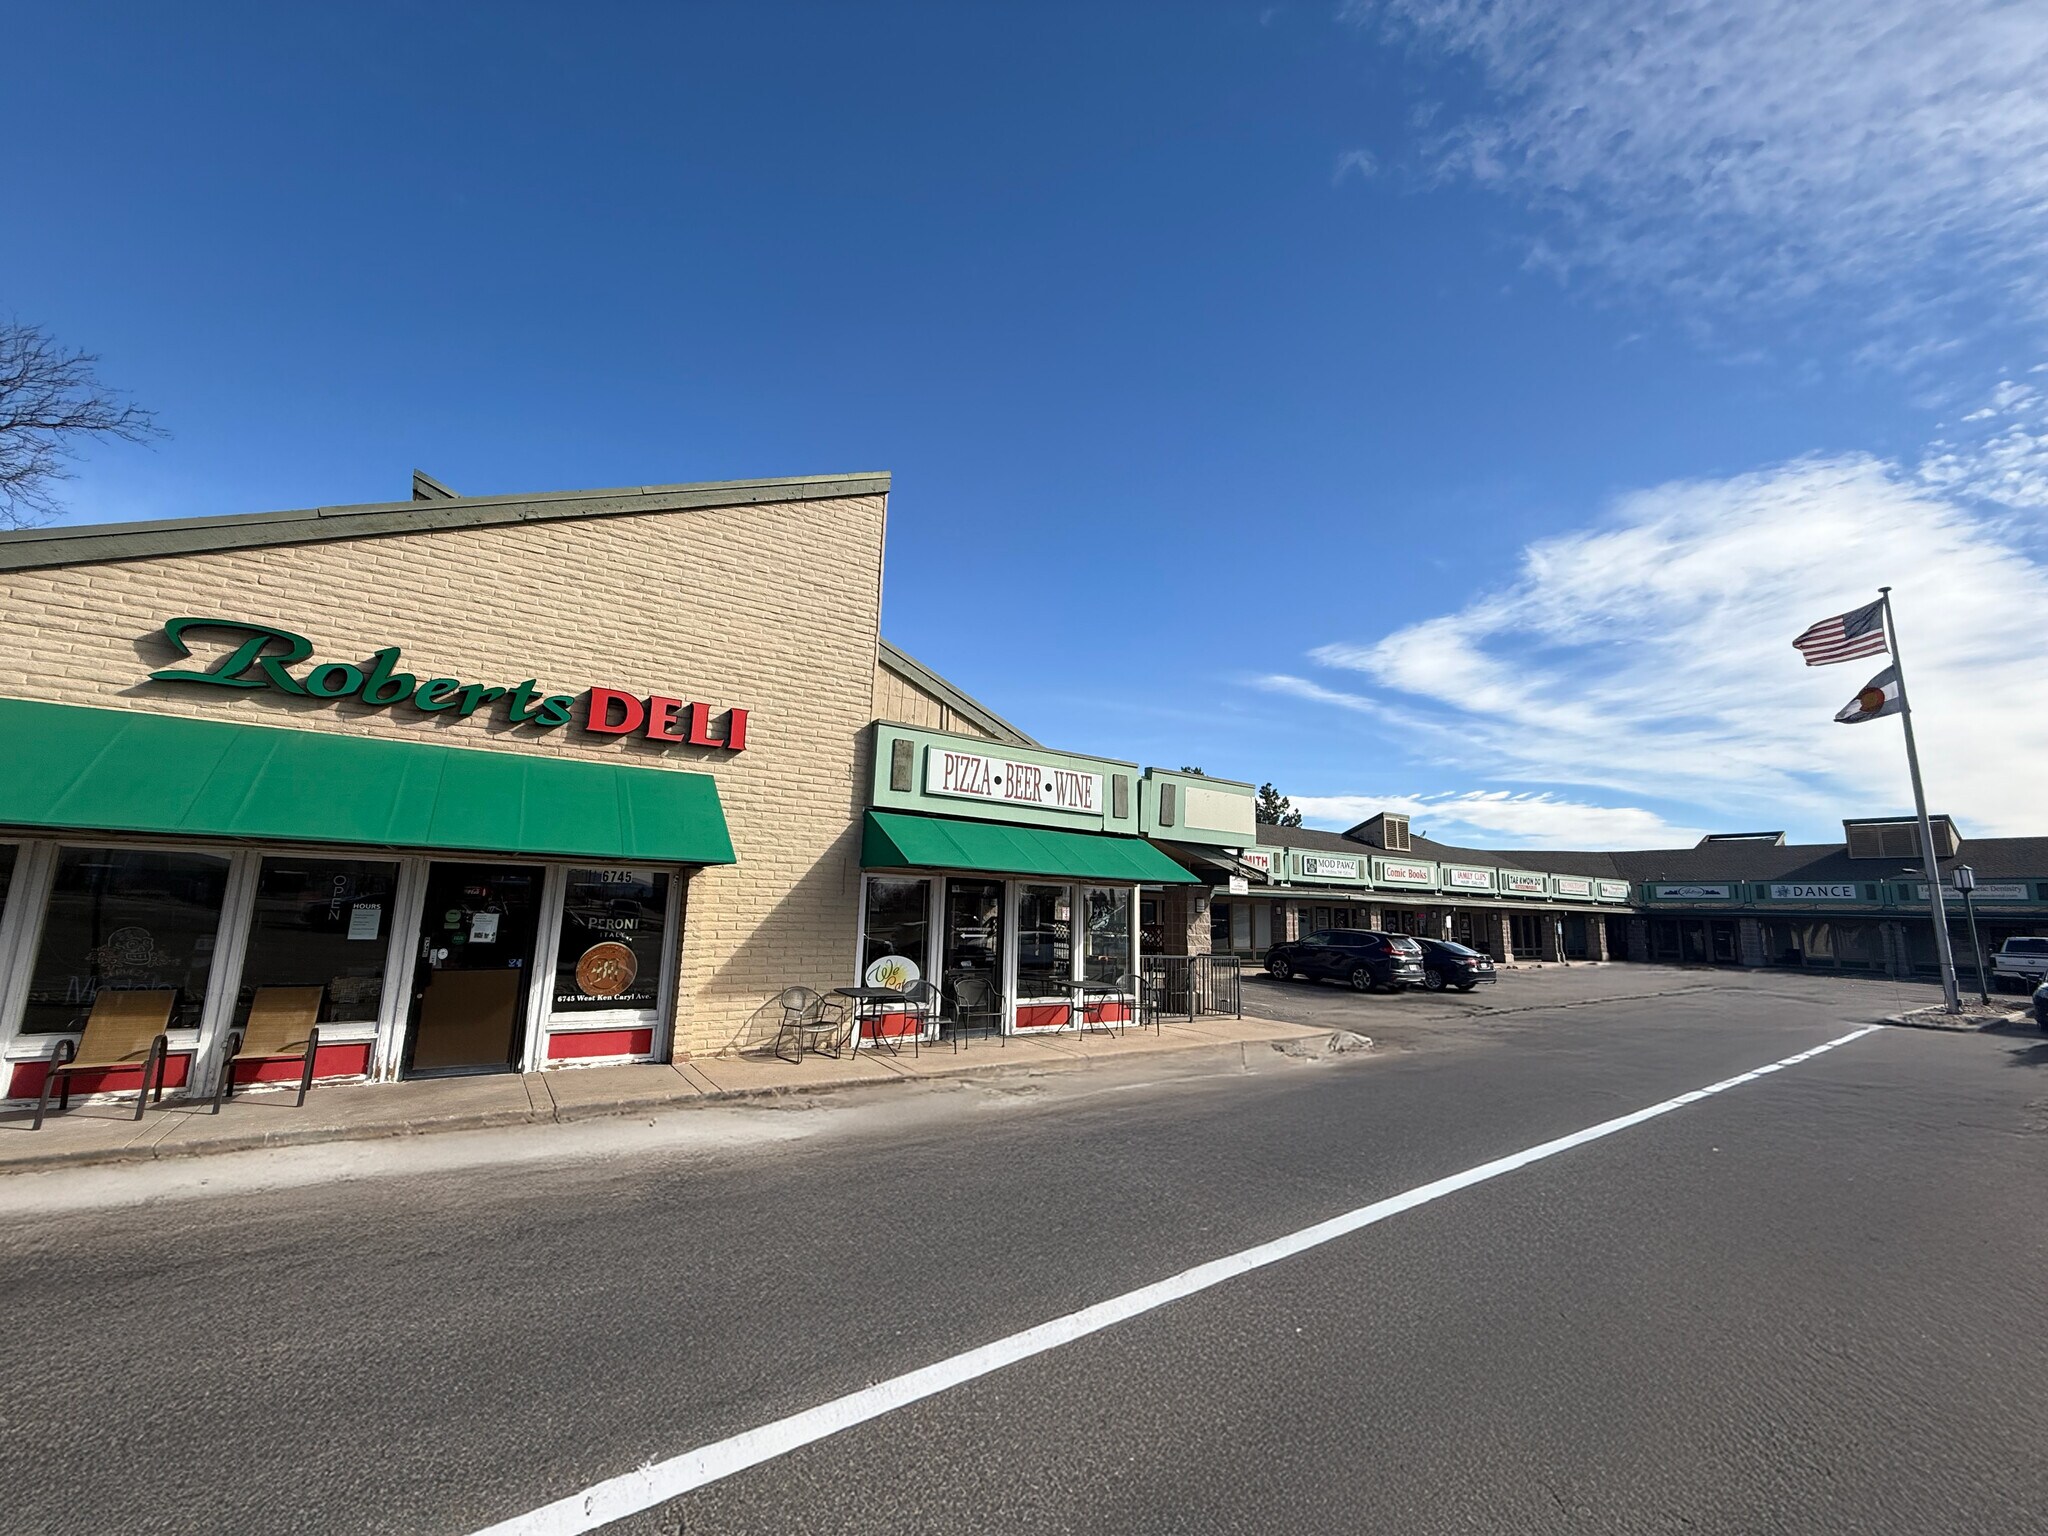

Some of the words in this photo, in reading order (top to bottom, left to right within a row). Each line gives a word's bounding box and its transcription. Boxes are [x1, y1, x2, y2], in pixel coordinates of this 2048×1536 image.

[149, 617, 574, 726] Roberts
[584, 686, 749, 751] DELI
[943, 754, 992, 796] PIZZA
[1004, 763, 1042, 803] BEER
[1054, 770, 1093, 809] WINE
[1318, 859, 1335, 869] MOD
[1336, 860, 1355, 870] PAWZ
[602, 870, 632, 883] 6745
[1386, 867, 1406, 878] Comic
[1408, 869, 1427, 880] Books
[328, 875, 347, 920] OPEN
[1793, 886, 1852, 897] DANCE
[587, 917, 640, 931] PERONI
[866, 959, 900, 983] We
[576, 994, 596, 1002] West
[597, 993, 612, 1001] Ken
[614, 993, 634, 1002] Caryl
[636, 992, 652, 1000] Ave.
